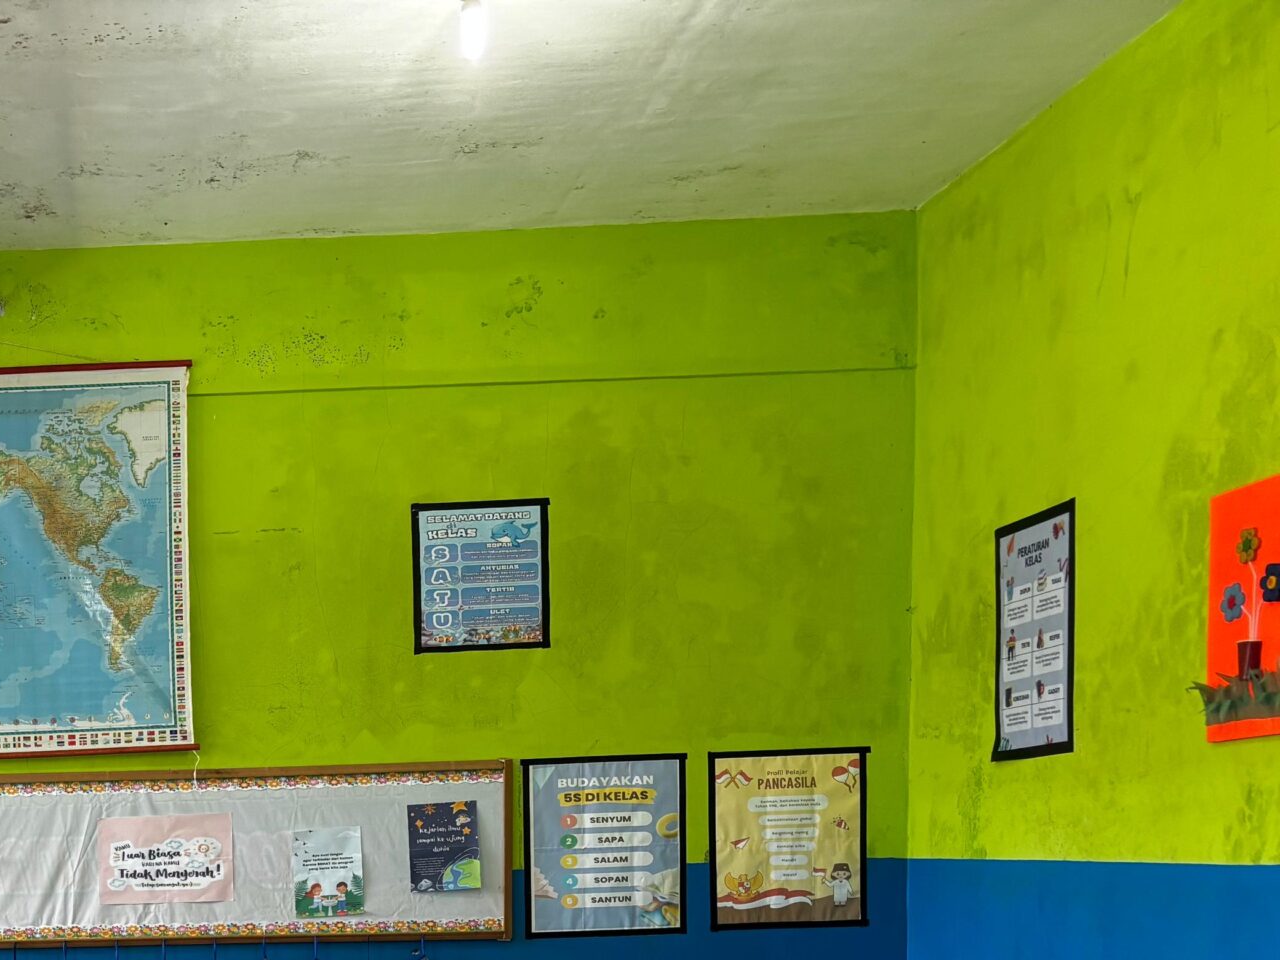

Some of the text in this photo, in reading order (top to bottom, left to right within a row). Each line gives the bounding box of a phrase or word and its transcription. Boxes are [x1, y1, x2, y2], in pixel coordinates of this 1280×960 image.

[427, 511, 531, 524] SELAMAT DATANG
[427, 528, 478, 541] KELAS
[1017, 538, 1050, 558] PERATURAN
[1024, 554, 1043, 569] KELAS
[766, 768, 809, 777] Profil Pelajar
[557, 775, 655, 789] BUDAYAKAN
[757, 776, 818, 790] PANCASILA
[563, 790, 649, 803] 5S DI KELAS
[589, 815, 632, 825] SENYUM
[446, 834, 466, 844] ujung
[597, 835, 625, 844] SAPA
[113, 843, 131, 852] KAMU
[432, 845, 450, 854] dunia
[121, 848, 183, 862] Luar Biasa
[593, 855, 629, 864] SALAM
[118, 868, 156, 881] Tidak
[566, 876, 629, 886] 4 SOPAN
[591, 895, 632, 904] SANTUN
